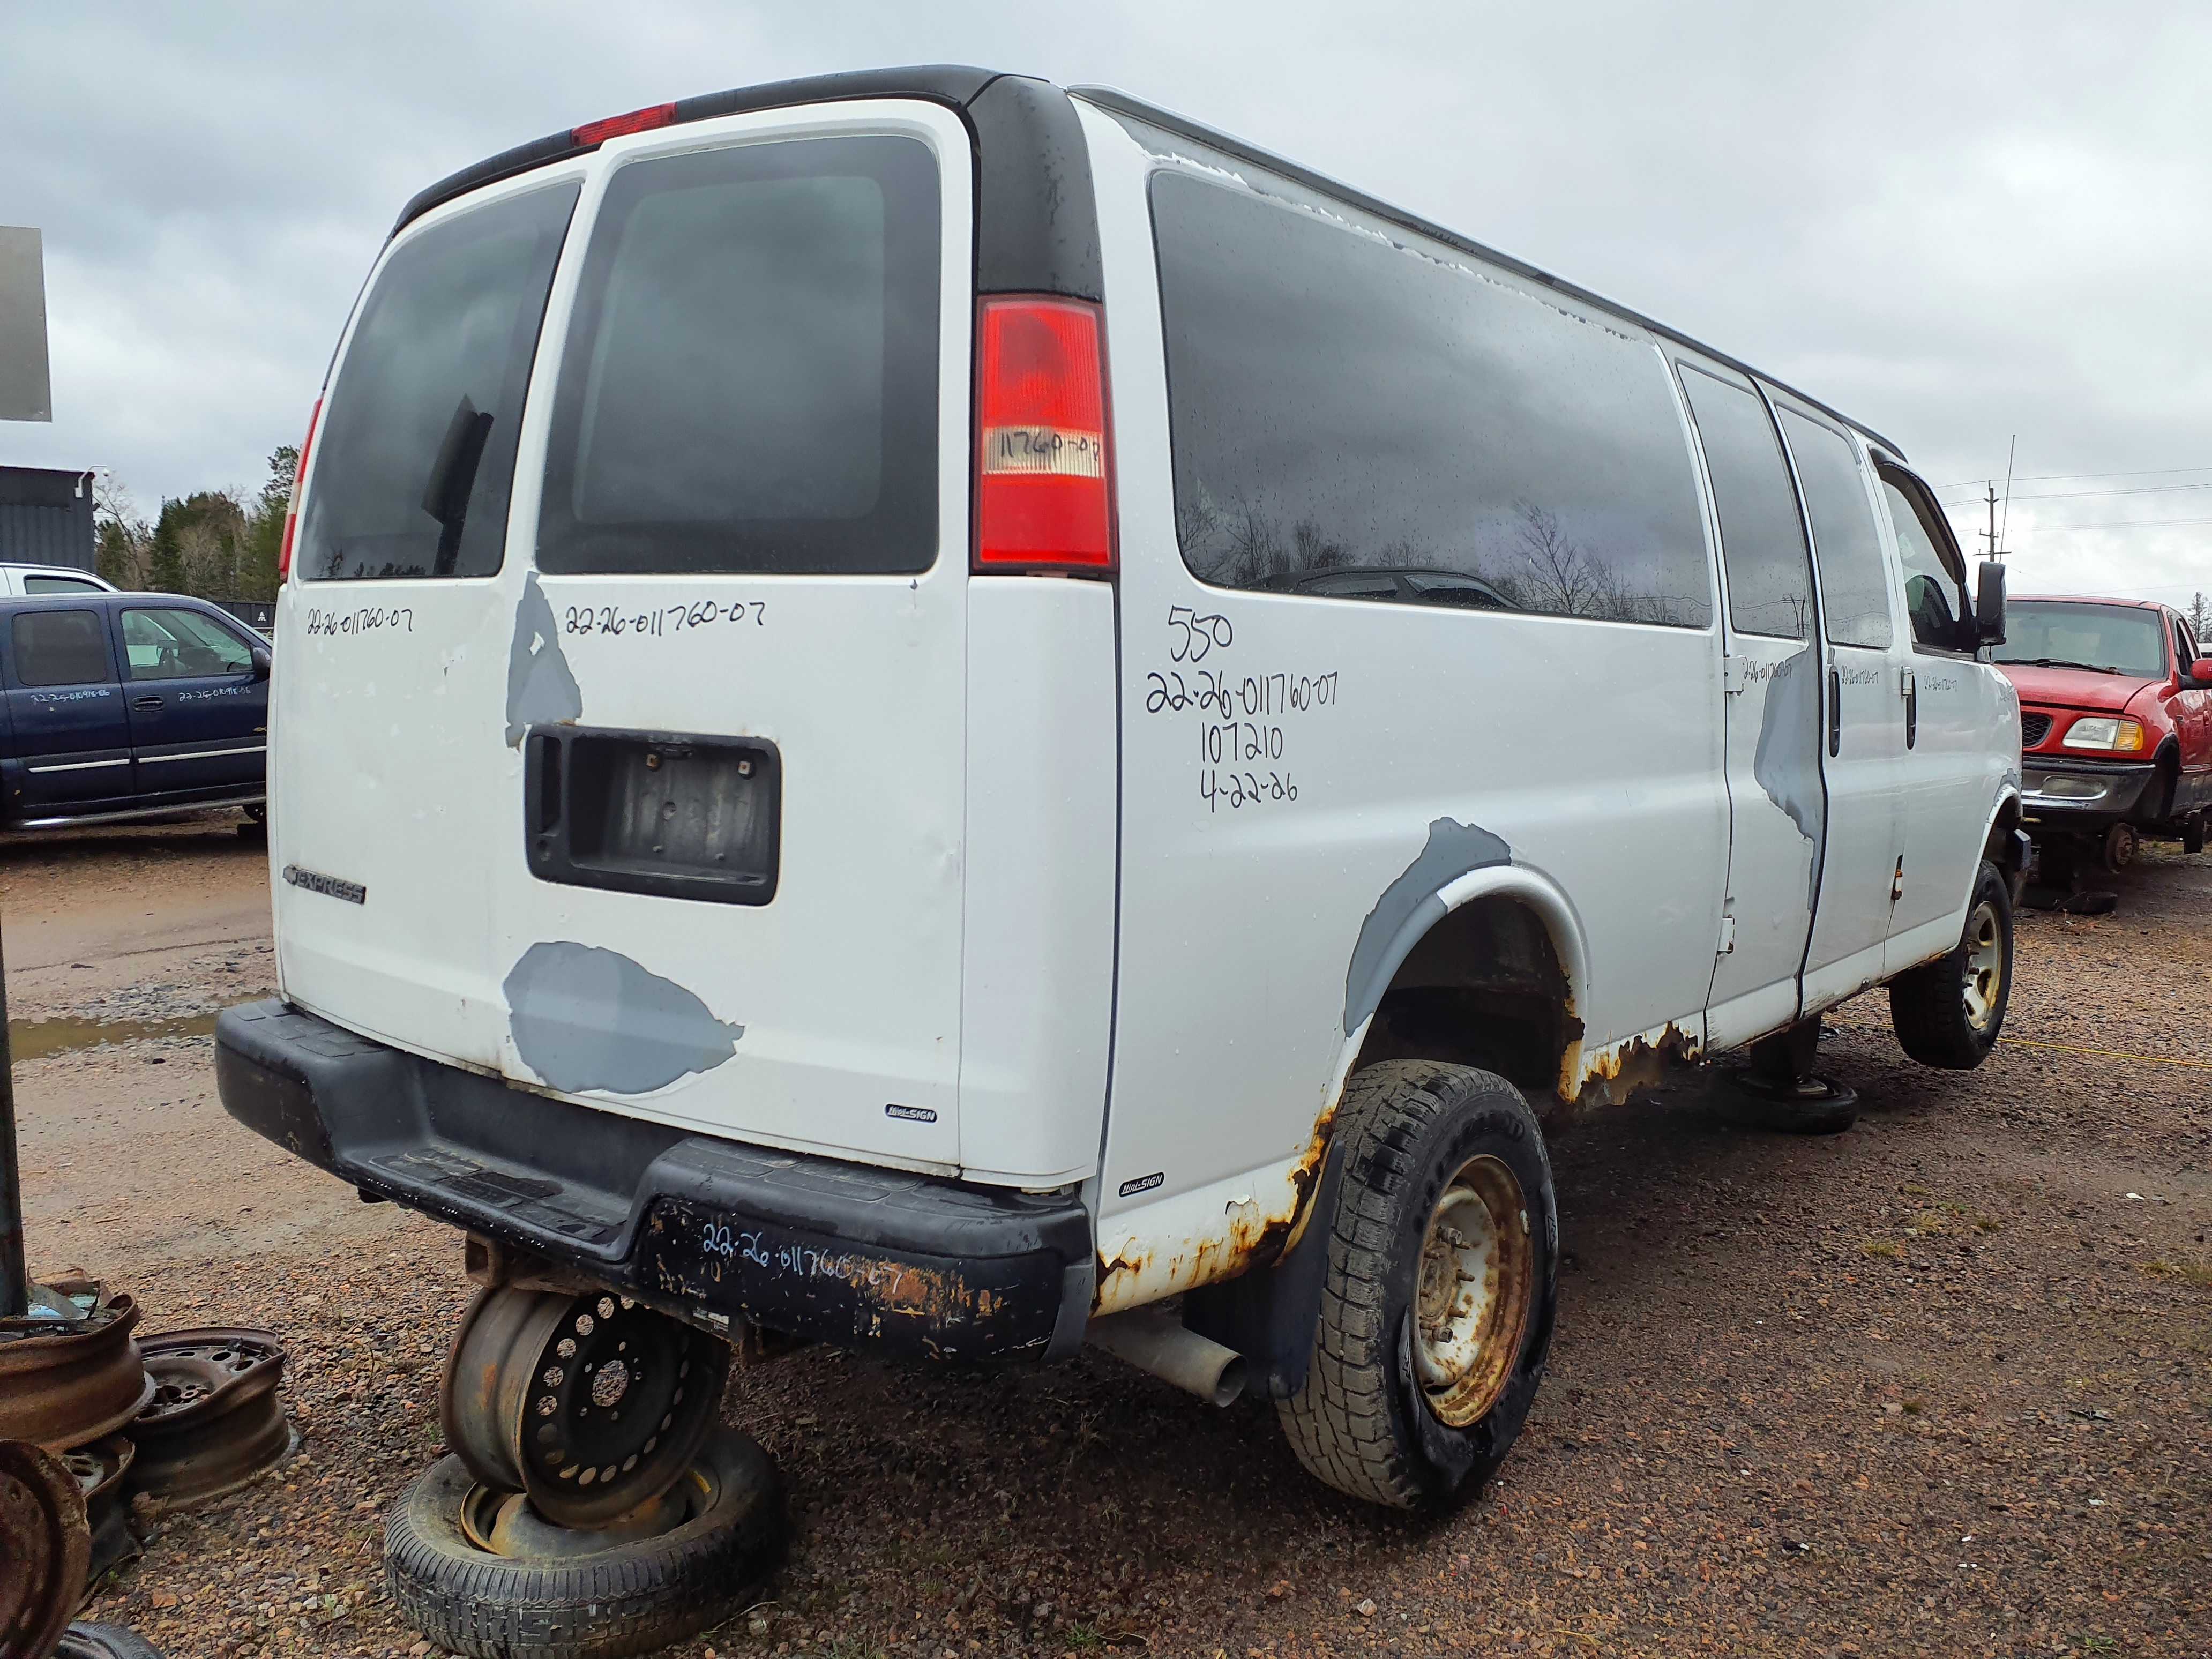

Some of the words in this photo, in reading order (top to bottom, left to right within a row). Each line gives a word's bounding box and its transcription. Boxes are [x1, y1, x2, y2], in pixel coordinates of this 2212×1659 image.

[1168, 605, 1232, 663] 550
[1201, 722, 1283, 764] 107210
[1200, 768, 1298, 813] 4-22-26
[296, 869, 365, 905] EXPRESS
